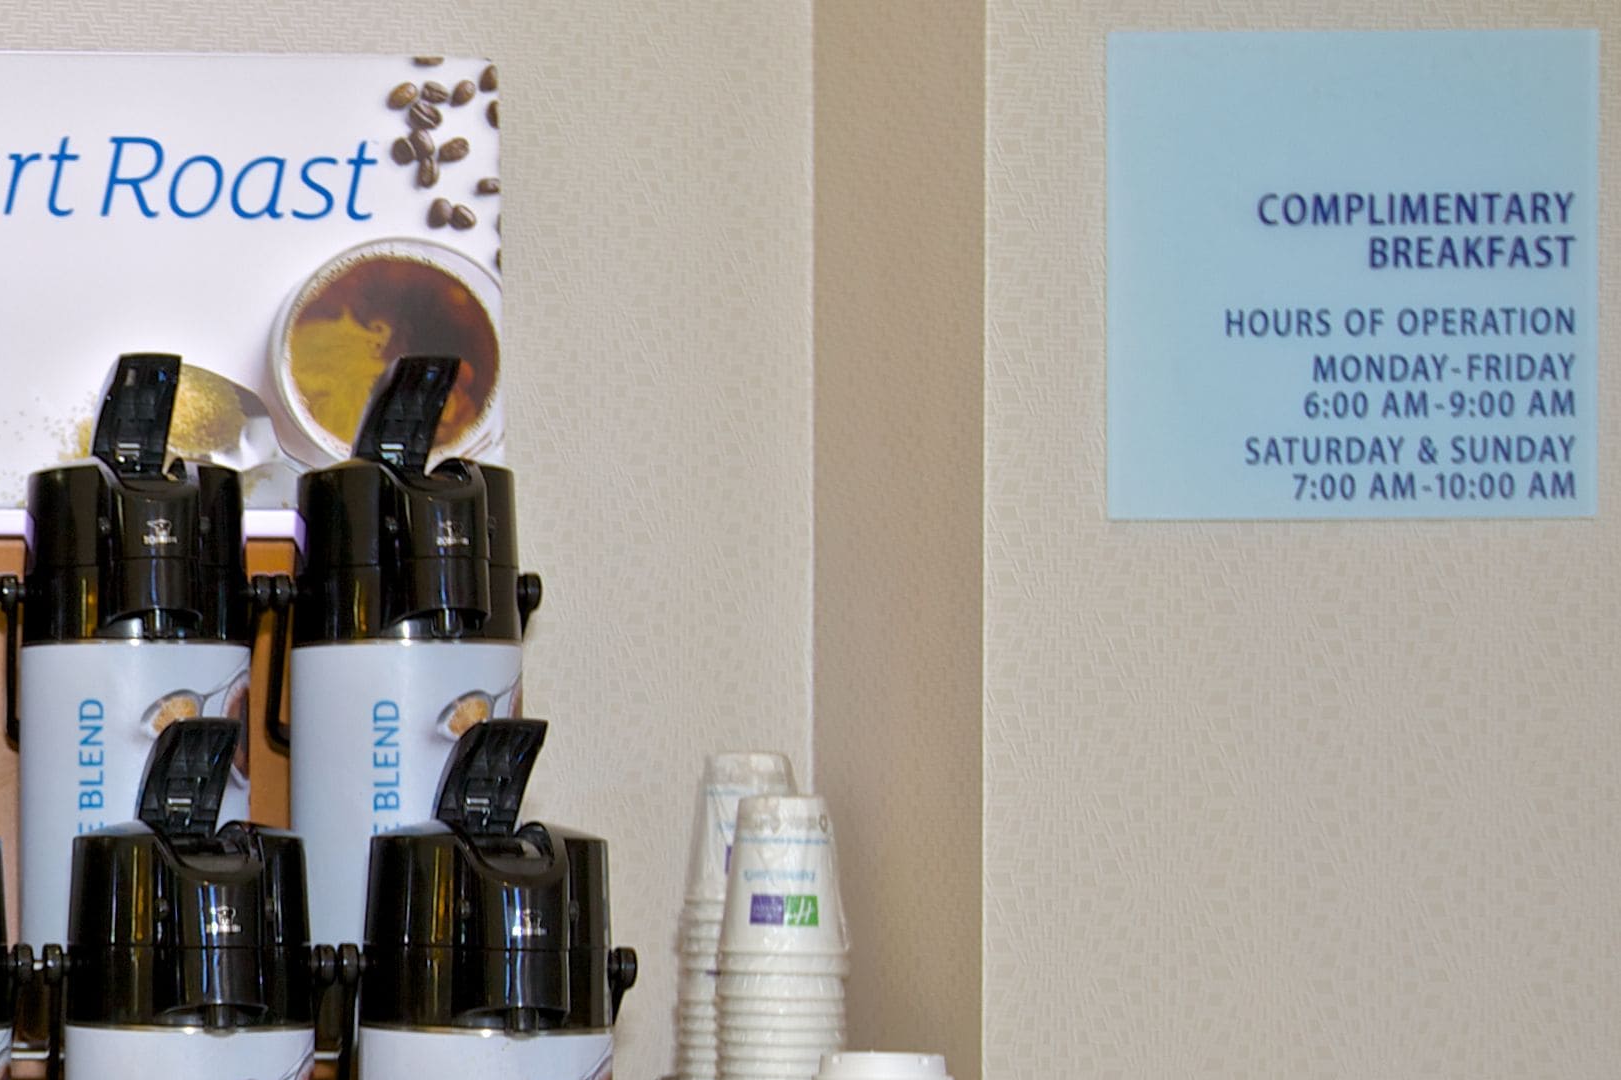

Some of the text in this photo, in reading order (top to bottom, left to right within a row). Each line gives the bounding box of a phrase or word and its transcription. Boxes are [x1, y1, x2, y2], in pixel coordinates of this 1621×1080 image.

[99, 136, 379, 221] Roast
[1257, 191, 1576, 227] COMPLIMENTARY
[1369, 234, 1577, 269] BREAKFAST
[1225, 307, 1576, 338] HOURS OF OPERATION
[1312, 353, 1576, 383] MONDAY-FRIDAY
[1303, 390, 1370, 419] 6:00
[1528, 389, 1576, 417] AM
[1245, 435, 1576, 465] SATURDAY & SUNDAY
[1292, 473, 1357, 501] 7:00
[1528, 471, 1576, 499] AM
[78, 698, 105, 811] BLEND
[372, 699, 400, 813] BLEND
